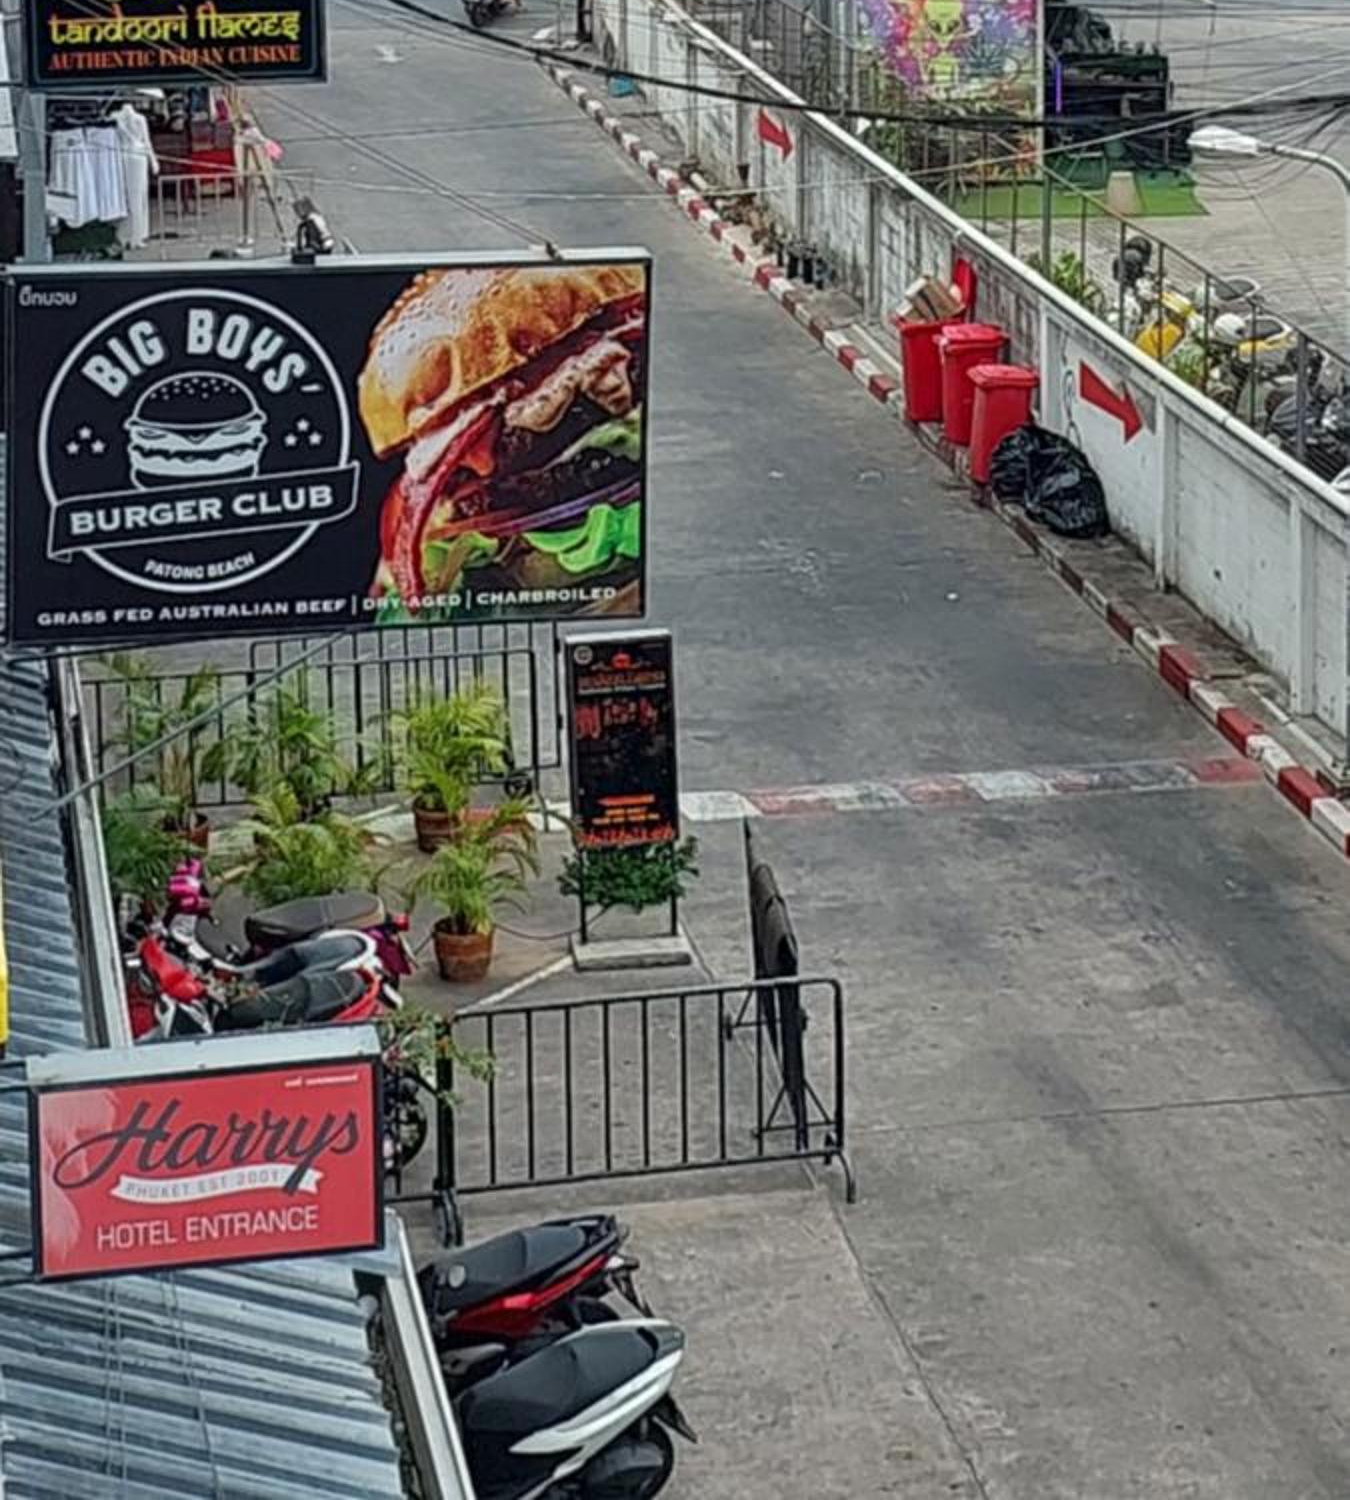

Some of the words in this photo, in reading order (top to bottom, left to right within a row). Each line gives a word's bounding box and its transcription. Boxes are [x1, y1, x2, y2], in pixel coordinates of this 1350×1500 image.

[48, 3, 188, 44] tandoori
[48, 49, 154, 70] AUTHENTIC
[159, 47, 224, 67] INDIAN
[228, 44, 300, 64] CUISINE
[81, 320, 166, 398] BIG
[70, 498, 222, 535] BURGER
[232, 485, 334, 517] CLUB
[144, 559, 204, 579] PATONG
[207, 551, 255, 577] BEACH
[37, 610, 107, 626] GRASS
[113, 608, 153, 622] FED
[158, 602, 288, 620] AUSTRALIAN
[295, 598, 347, 614] BEEF
[476, 586, 617, 606] CHARBROILED
[53, 1098, 360, 1195] Harrys
[126, 1182, 190, 1198] PHUKET
[195, 1173, 227, 1190] EST
[235, 1169, 280, 1186] 2001
[97, 1220, 177, 1250] HOTEL
[186, 1205, 319, 1240] ENTRANCE
